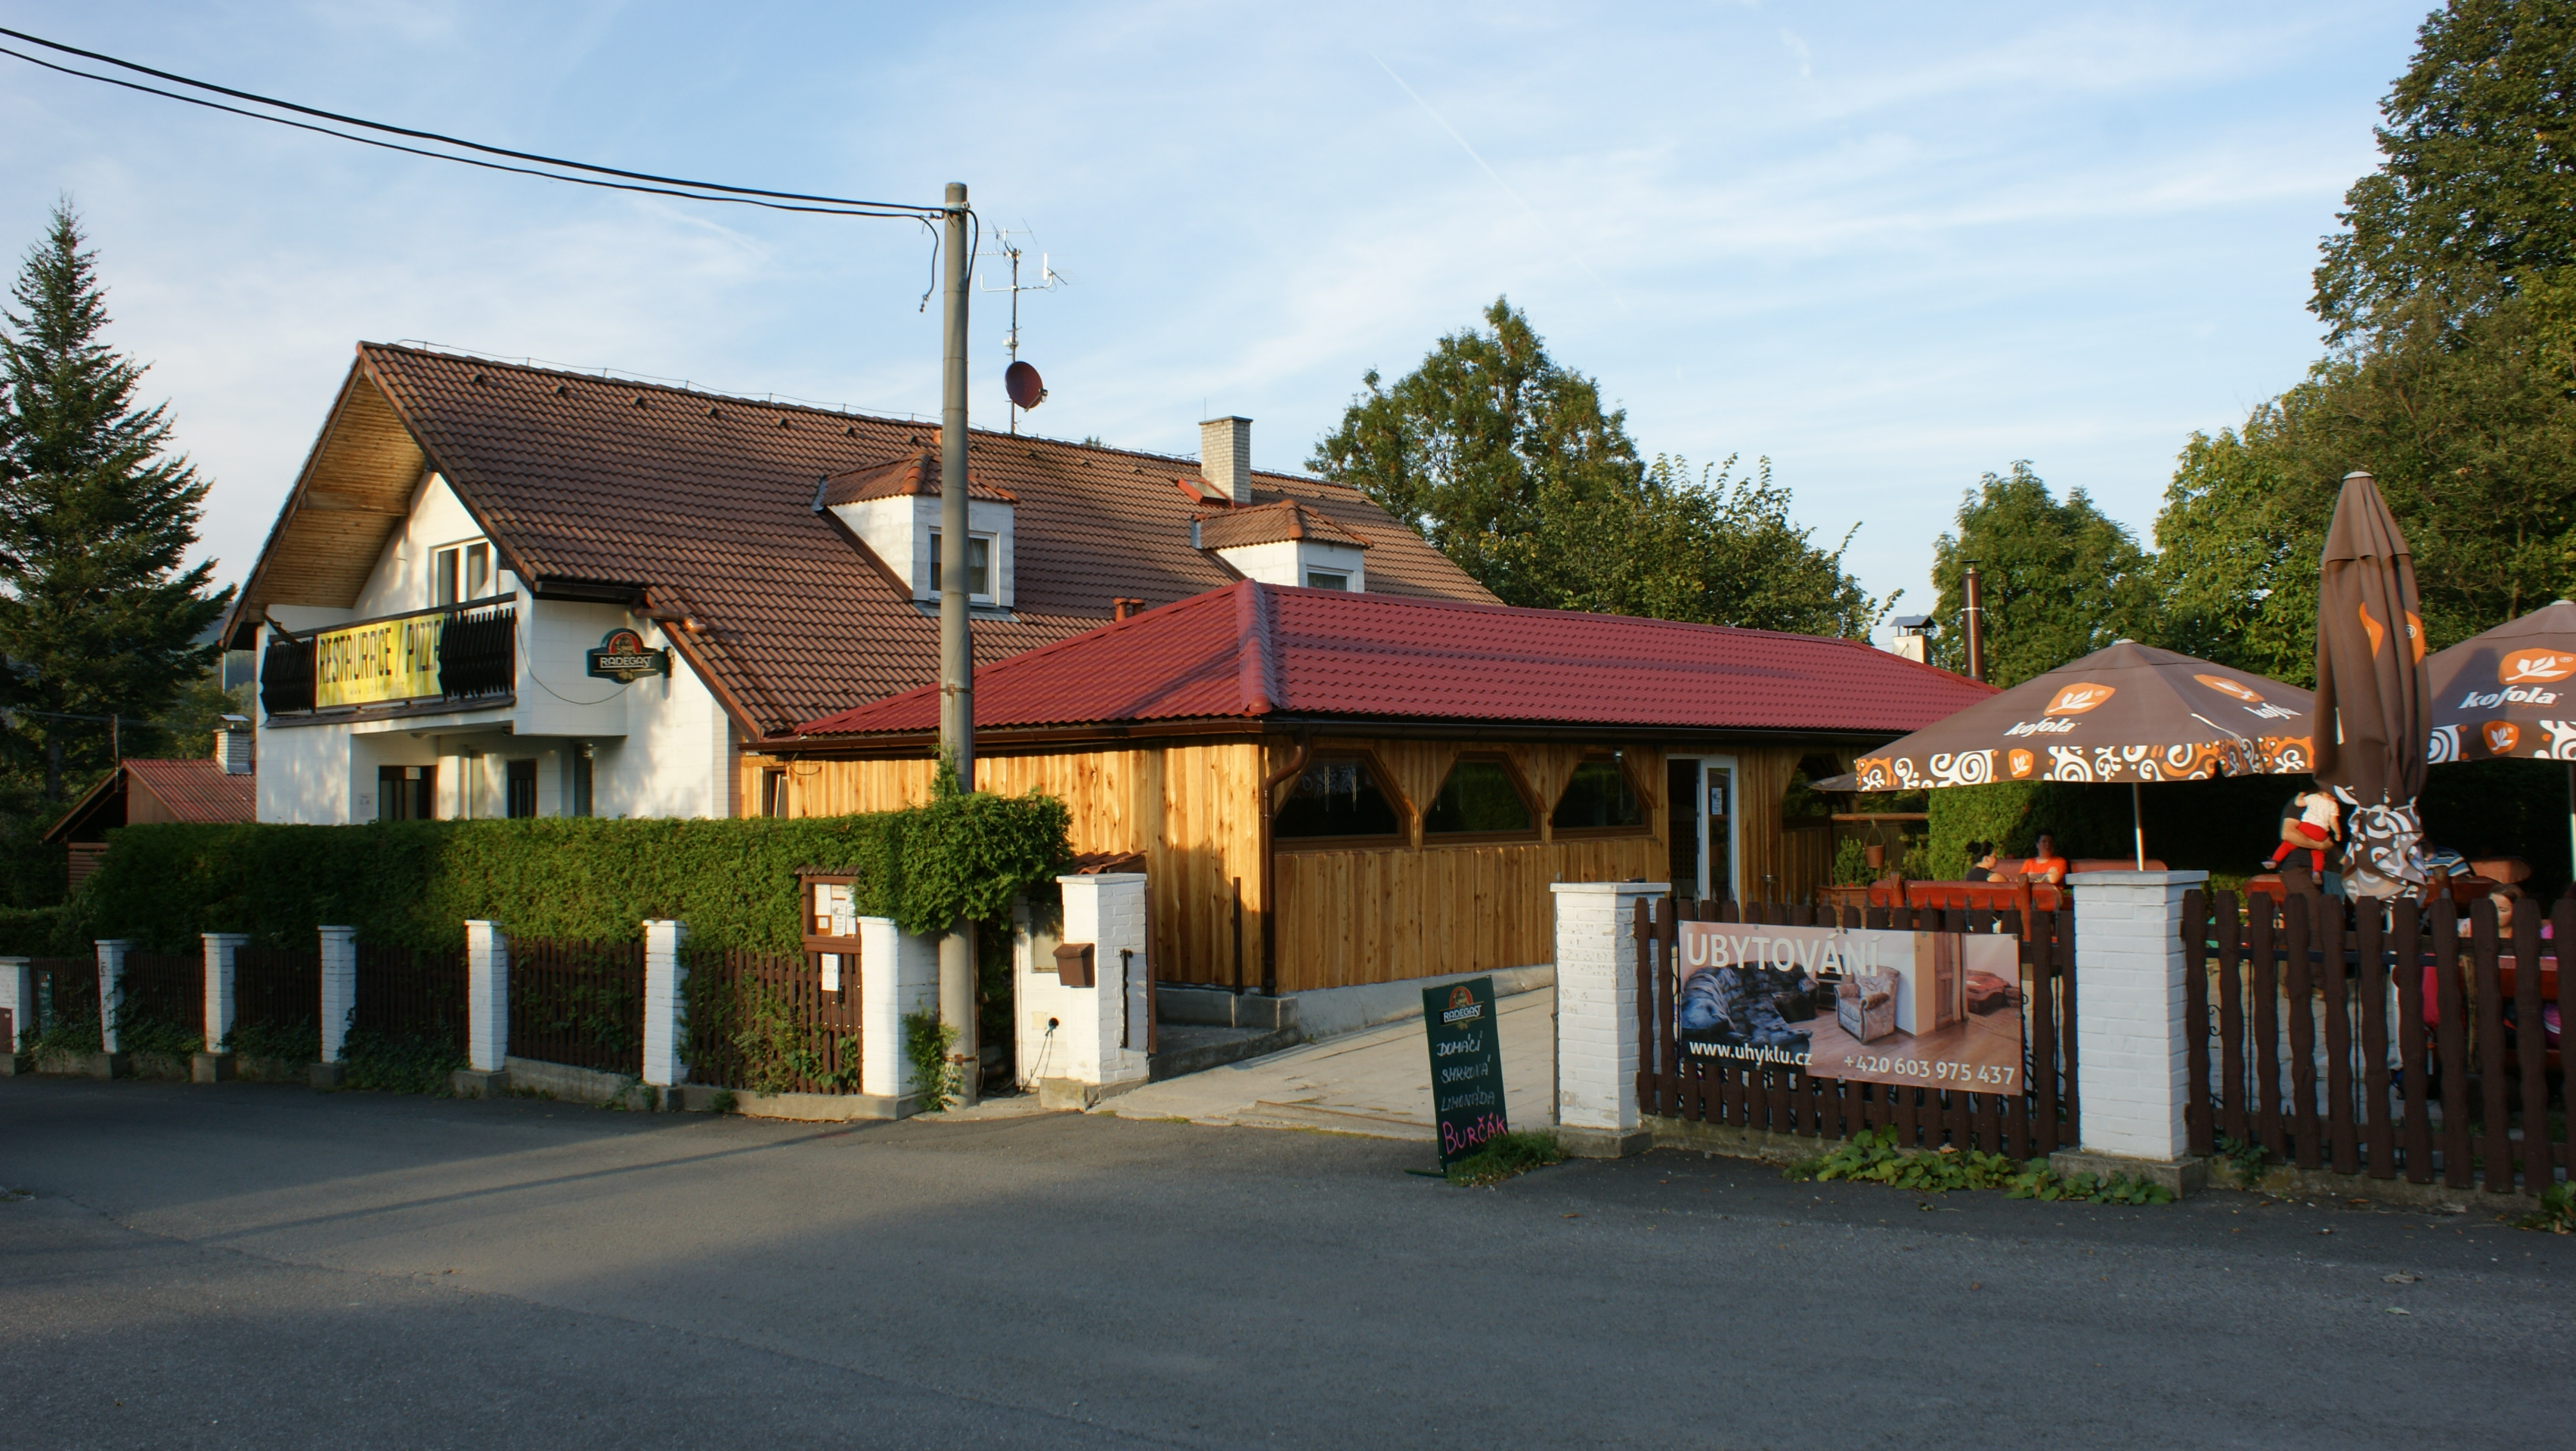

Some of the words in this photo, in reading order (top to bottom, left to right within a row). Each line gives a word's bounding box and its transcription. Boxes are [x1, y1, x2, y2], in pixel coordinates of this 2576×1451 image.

[319, 627, 391, 685] RESTAURACE
[600, 655, 652, 669] RADEGAST
[2458, 685, 2558, 709] kofola
[2003, 717, 2077, 738] kofola
[1686, 933, 1884, 977] UBYTOVÁNÍ
[1443, 1004, 1482, 1023] RADEGAST
[1689, 1041, 1813, 1066] www.uhyklu.cz
[1844, 1056, 1889, 1073] +420
[1894, 1058, 1930, 1078] 603
[1936, 1061, 1971, 1081] 975
[1977, 1065, 2015, 1084] 437
